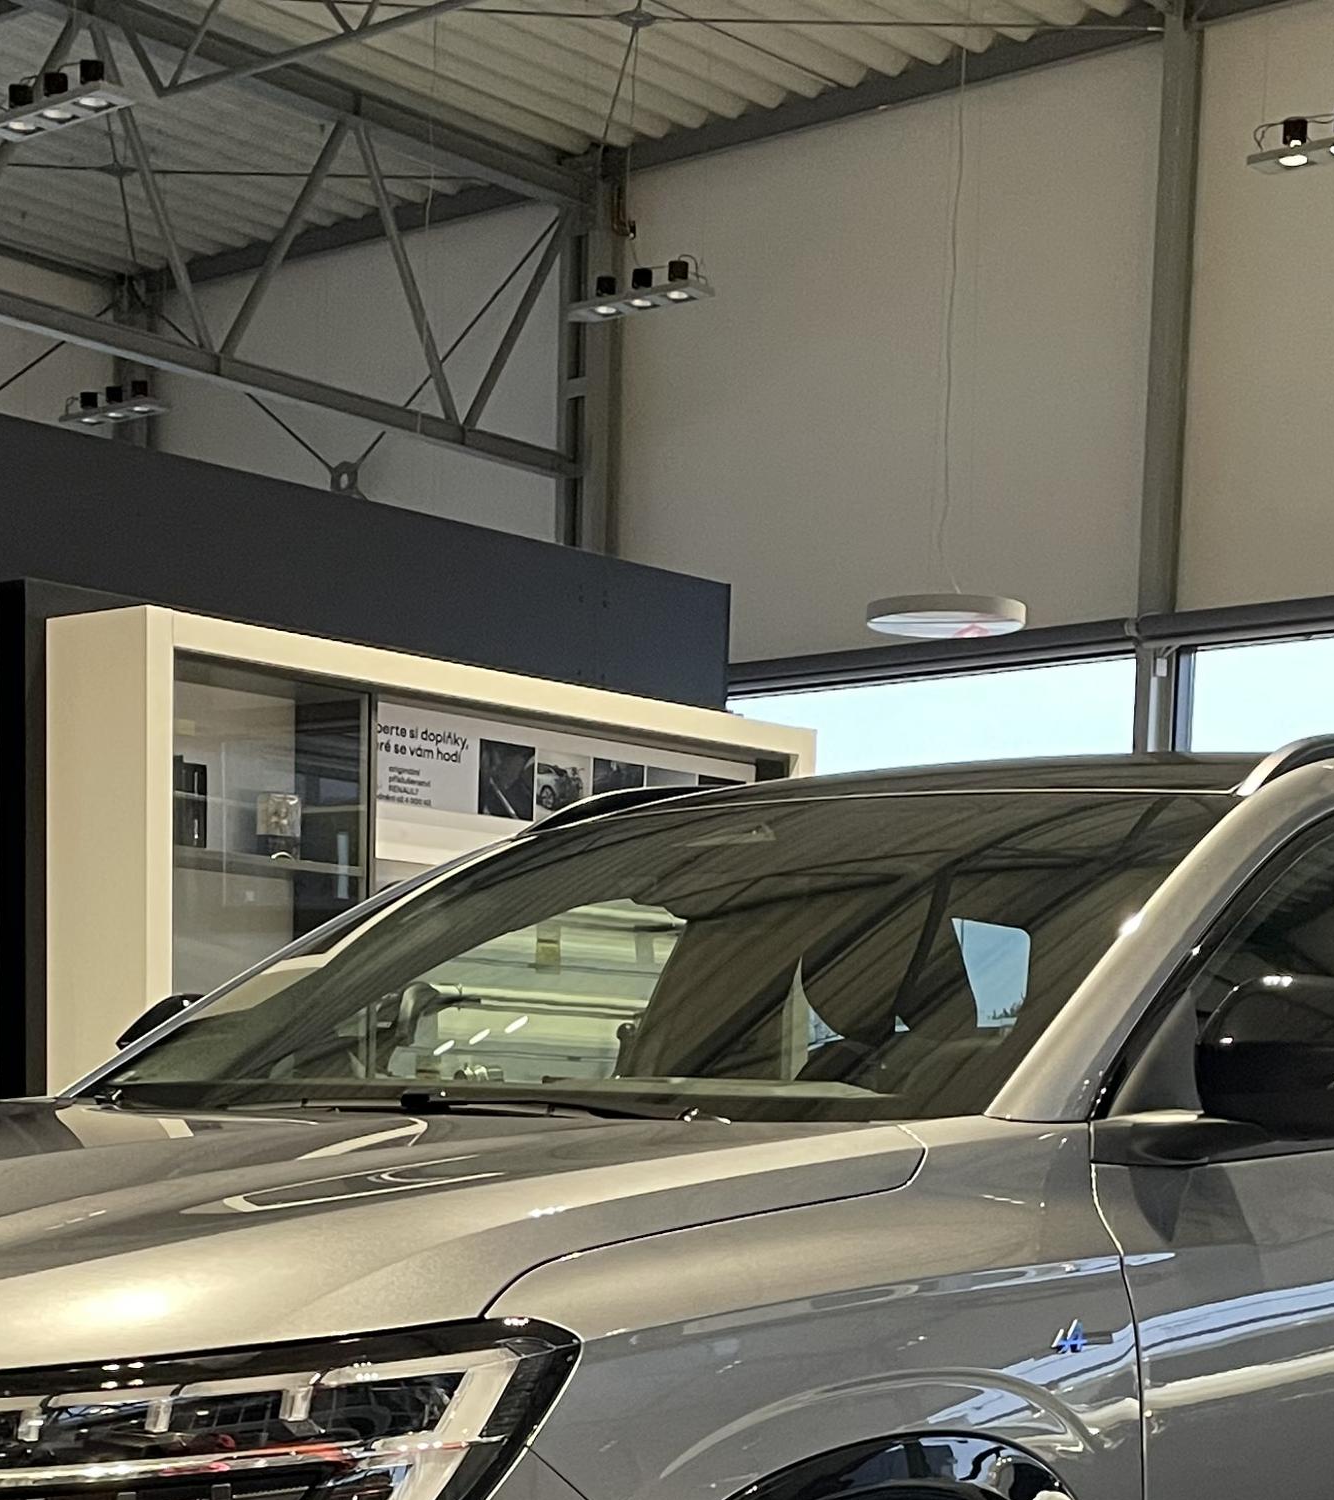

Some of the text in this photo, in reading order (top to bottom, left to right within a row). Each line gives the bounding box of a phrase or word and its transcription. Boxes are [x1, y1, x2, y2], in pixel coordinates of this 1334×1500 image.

[409, 726, 418, 738] si
[421, 728, 468, 751] doplňky,
[394, 743, 407, 755] se
[409, 745, 434, 760] vám
[437, 747, 462, 763] hodí
